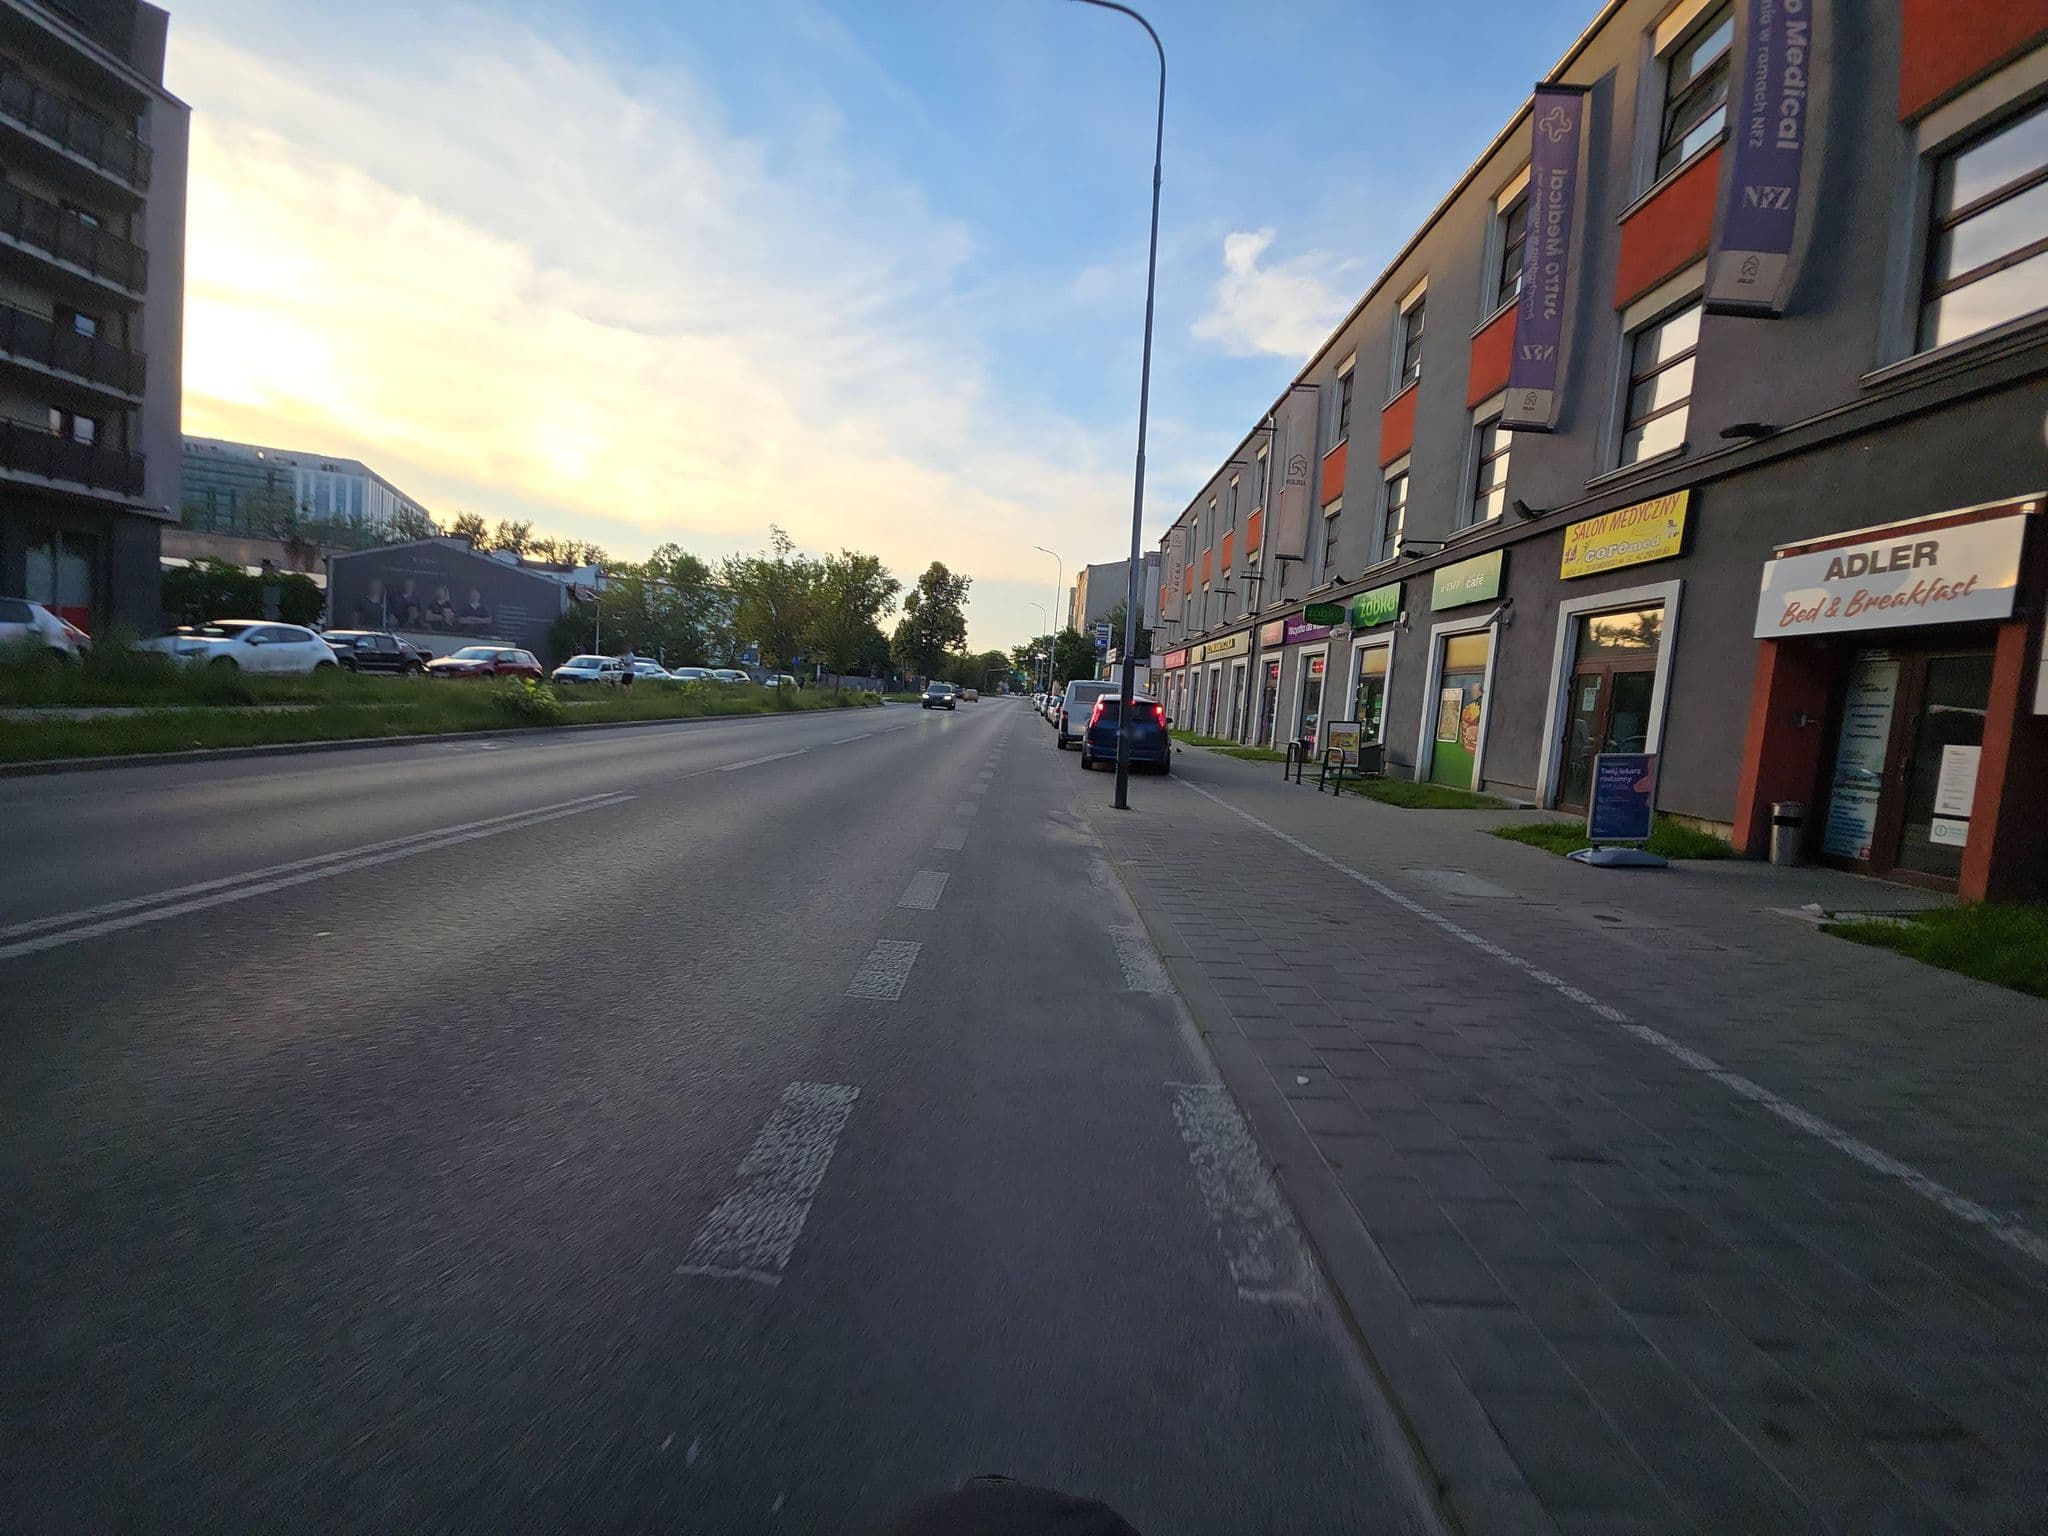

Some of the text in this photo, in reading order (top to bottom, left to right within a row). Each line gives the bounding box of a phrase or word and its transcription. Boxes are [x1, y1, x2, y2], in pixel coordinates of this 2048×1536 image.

[1753, 46, 1769, 114] ramach
[1776, 21, 1808, 149] Medical
[1750, 117, 1766, 150] NFZ
[1742, 185, 1792, 210] NFZ
[1573, 515, 1609, 543] SALON
[1609, 493, 1681, 532] MEDYCZNY
[1823, 540, 1940, 582] ADLER
[1779, 574, 1979, 627] Bed & Breakfast
